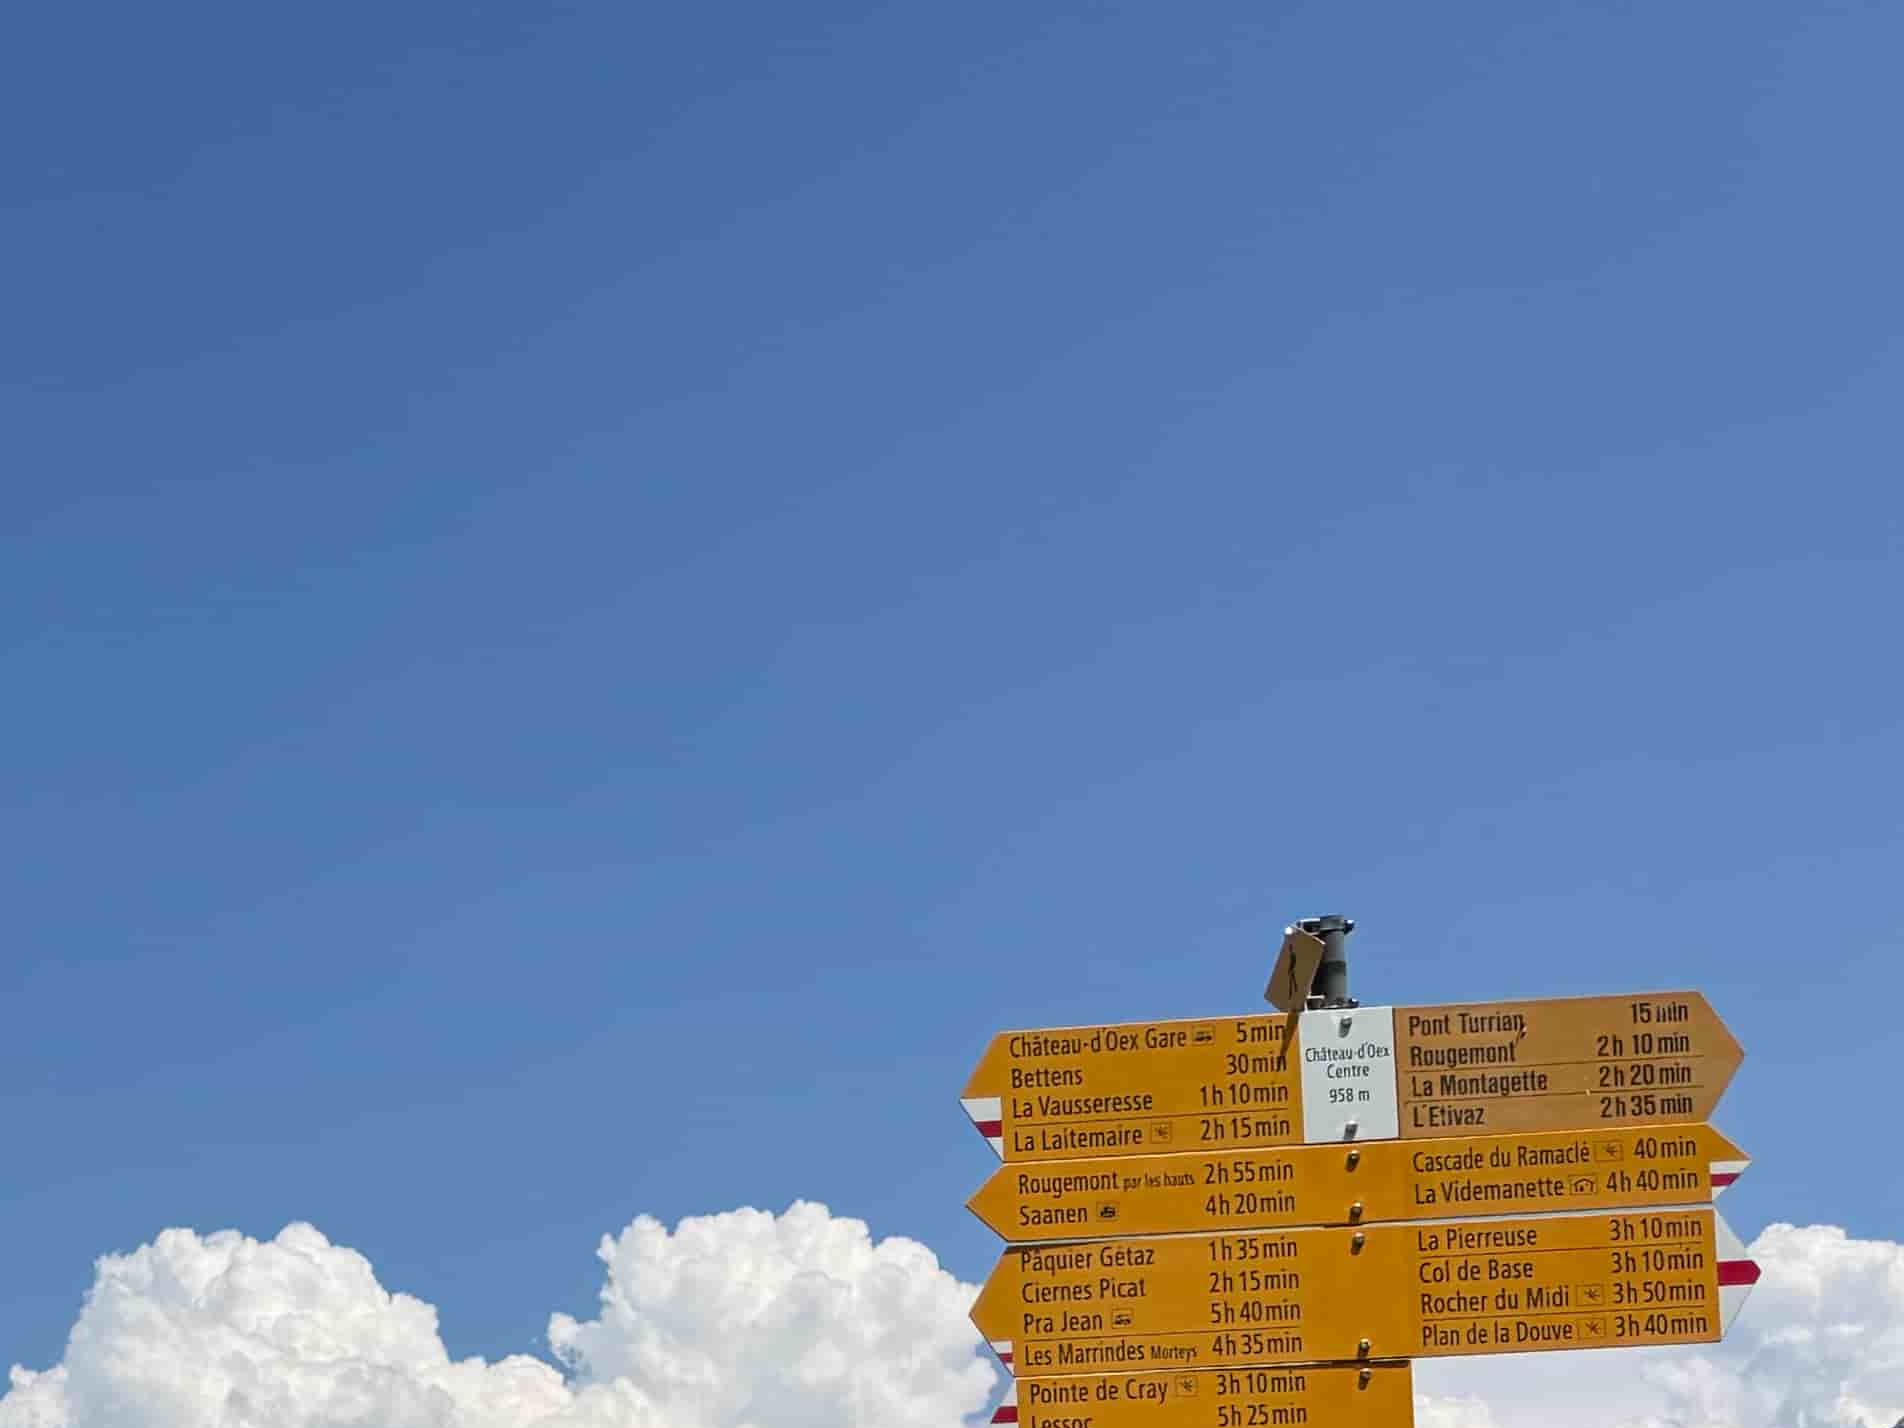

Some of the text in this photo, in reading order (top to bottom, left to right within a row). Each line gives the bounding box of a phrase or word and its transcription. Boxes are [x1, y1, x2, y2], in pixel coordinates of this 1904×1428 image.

[1409, 1012, 1526, 1036] Pont Turrian
[1145, 1028, 1186, 1048] Gare
[1410, 1041, 1515, 1068] Rougemont
[1012, 1068, 1082, 1088] Bettens
[1327, 1064, 1369, 1078] Centre
[1330, 1088, 1369, 1103] 958 m
[1412, 1076, 1432, 1096] La
[1440, 1071, 1547, 1100] Montagette
[1013, 1098, 1032, 1119] La
[1038, 1095, 1152, 1116] Vausseresse
[1015, 1132, 1034, 1152] La
[1413, 1147, 1483, 1172] Cascade
[1490, 1145, 1510, 1167] du
[1019, 1172, 1119, 1198] Rougemont
[1416, 1184, 1436, 1204] La
[1440, 1178, 1564, 1202] Videmanette
[1020, 1206, 1087, 1226] Saanen
[1418, 1231, 1438, 1251] La
[1447, 1228, 1536, 1249] Pierreuse
[1022, 1250, 1092, 1276] Pâquier
[1420, 1260, 1449, 1283] Col
[1458, 1260, 1480, 1280] de
[1488, 1259, 1533, 1280] Base
[1022, 1283, 1092, 1303] Ciernes
[1100, 1278, 1146, 1298] Picat
[1421, 1290, 1488, 1314] Rocher
[1495, 1288, 1518, 1310] du
[1527, 1285, 1568, 1309] Midi
[1024, 1313, 1053, 1334] Pra
[1061, 1311, 1102, 1332] Jean
[1422, 1324, 1459, 1346] Plan
[1467, 1322, 1488, 1344] de
[1494, 1320, 1509, 1344] la
[1516, 1317, 1572, 1342] Douve
[1025, 1345, 1052, 1366] Les
[1059, 1340, 1144, 1365] Marrindes
[1031, 1382, 1088, 1405] Pointe
[1096, 1378, 1118, 1400] de
[1126, 1379, 1168, 1404] Cray
